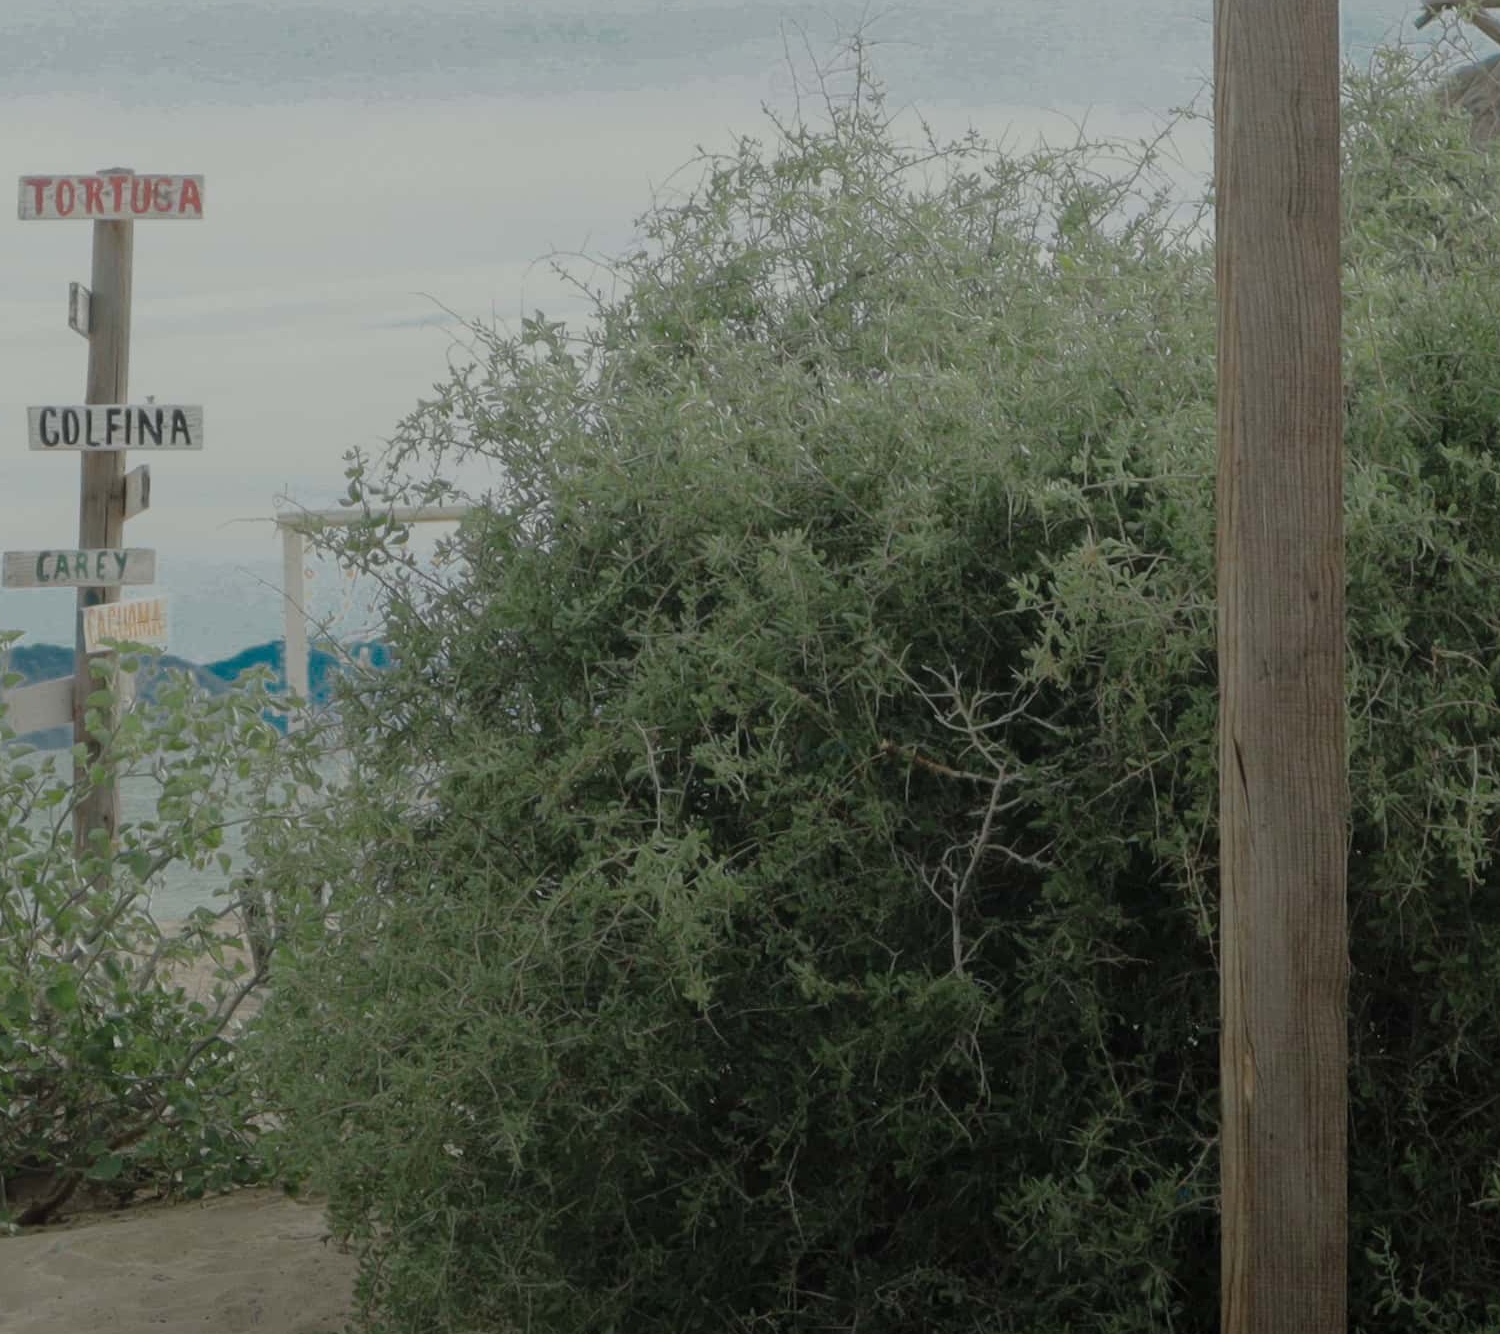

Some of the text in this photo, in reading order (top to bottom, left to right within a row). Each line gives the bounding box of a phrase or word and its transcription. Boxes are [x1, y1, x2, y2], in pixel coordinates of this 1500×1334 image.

[23, 175, 203, 217] TORTUGA
[39, 405, 193, 448] GOLFINA
[35, 550, 129, 583] CAREY
